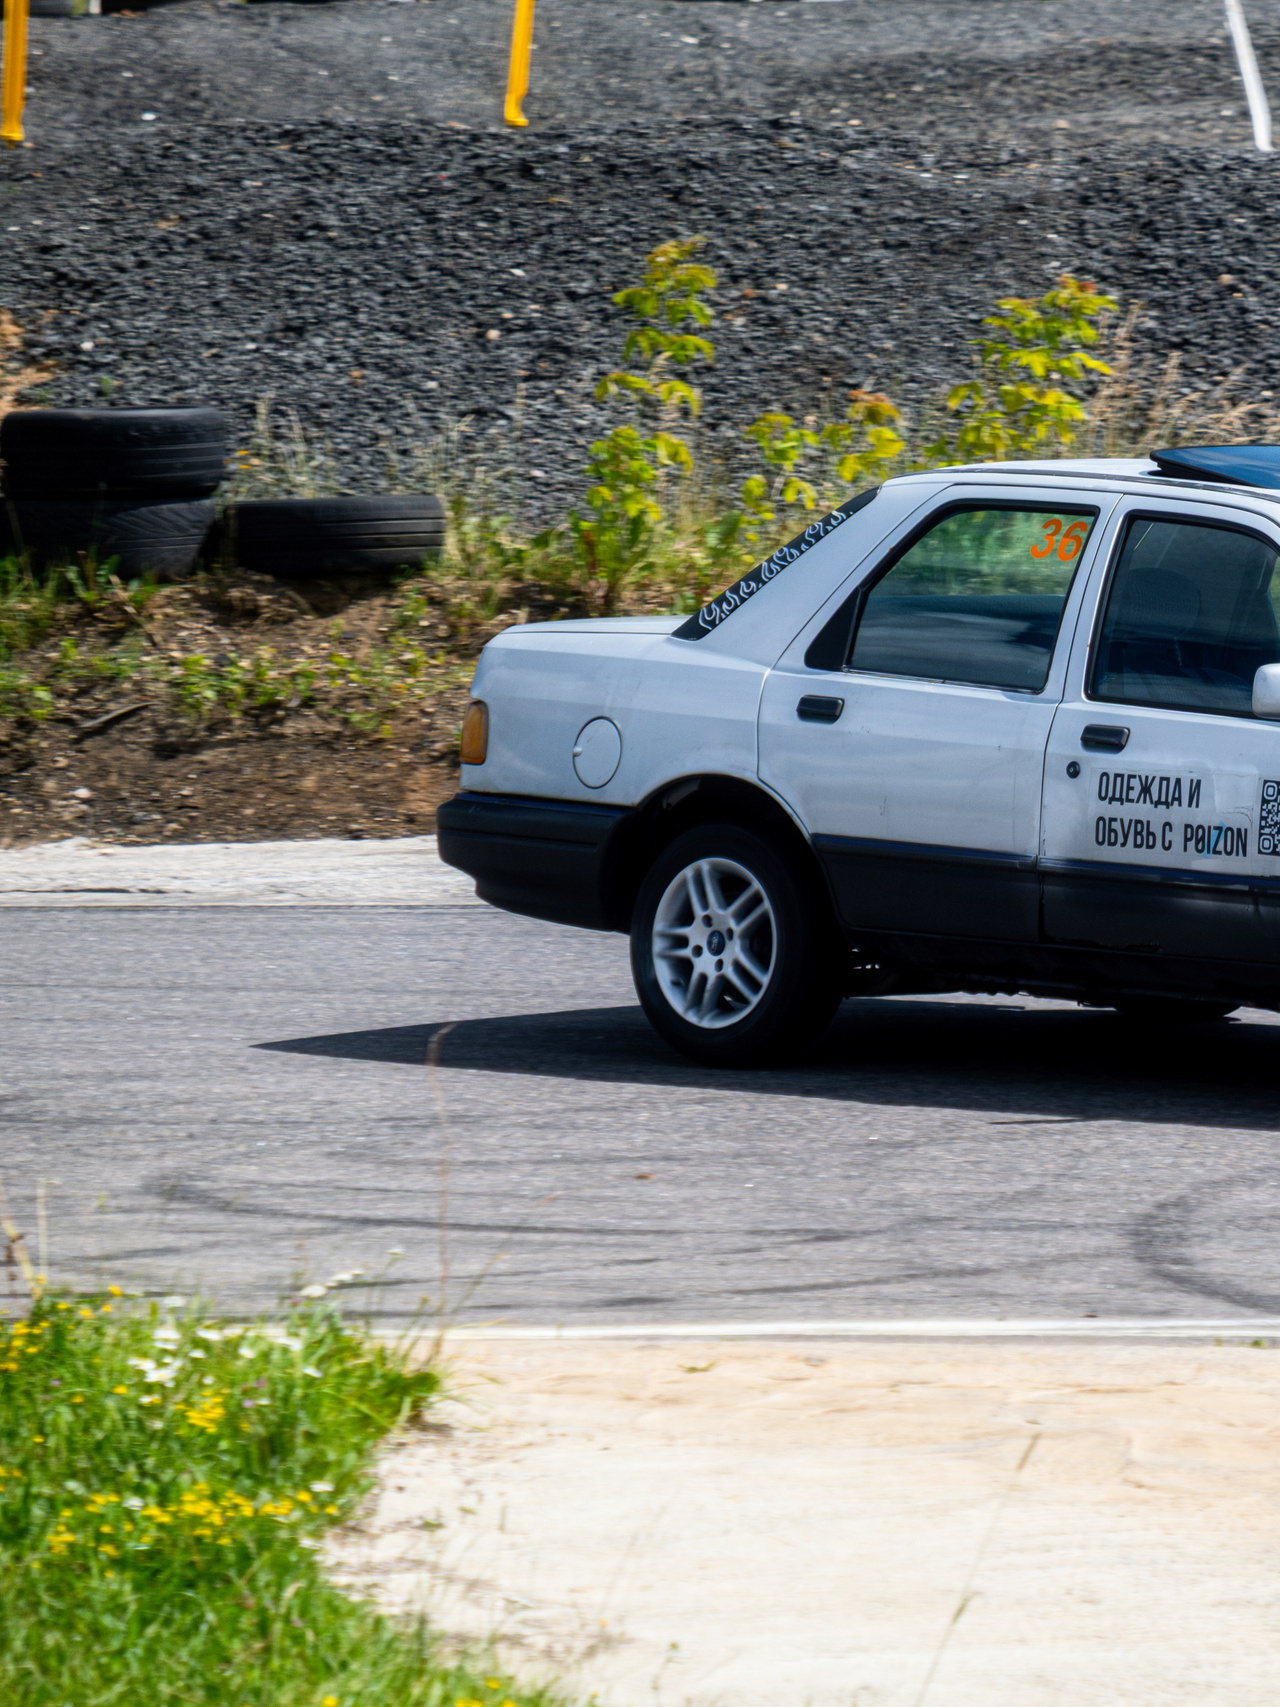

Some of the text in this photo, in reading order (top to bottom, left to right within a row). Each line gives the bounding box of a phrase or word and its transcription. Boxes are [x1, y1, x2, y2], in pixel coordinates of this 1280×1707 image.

[1029, 518, 1088, 562] 36
[1097, 771, 1202, 809] ОДЕЖДА И
[1095, 816, 1157, 850] ОБУВЬ
[1161, 821, 1173, 851] С
